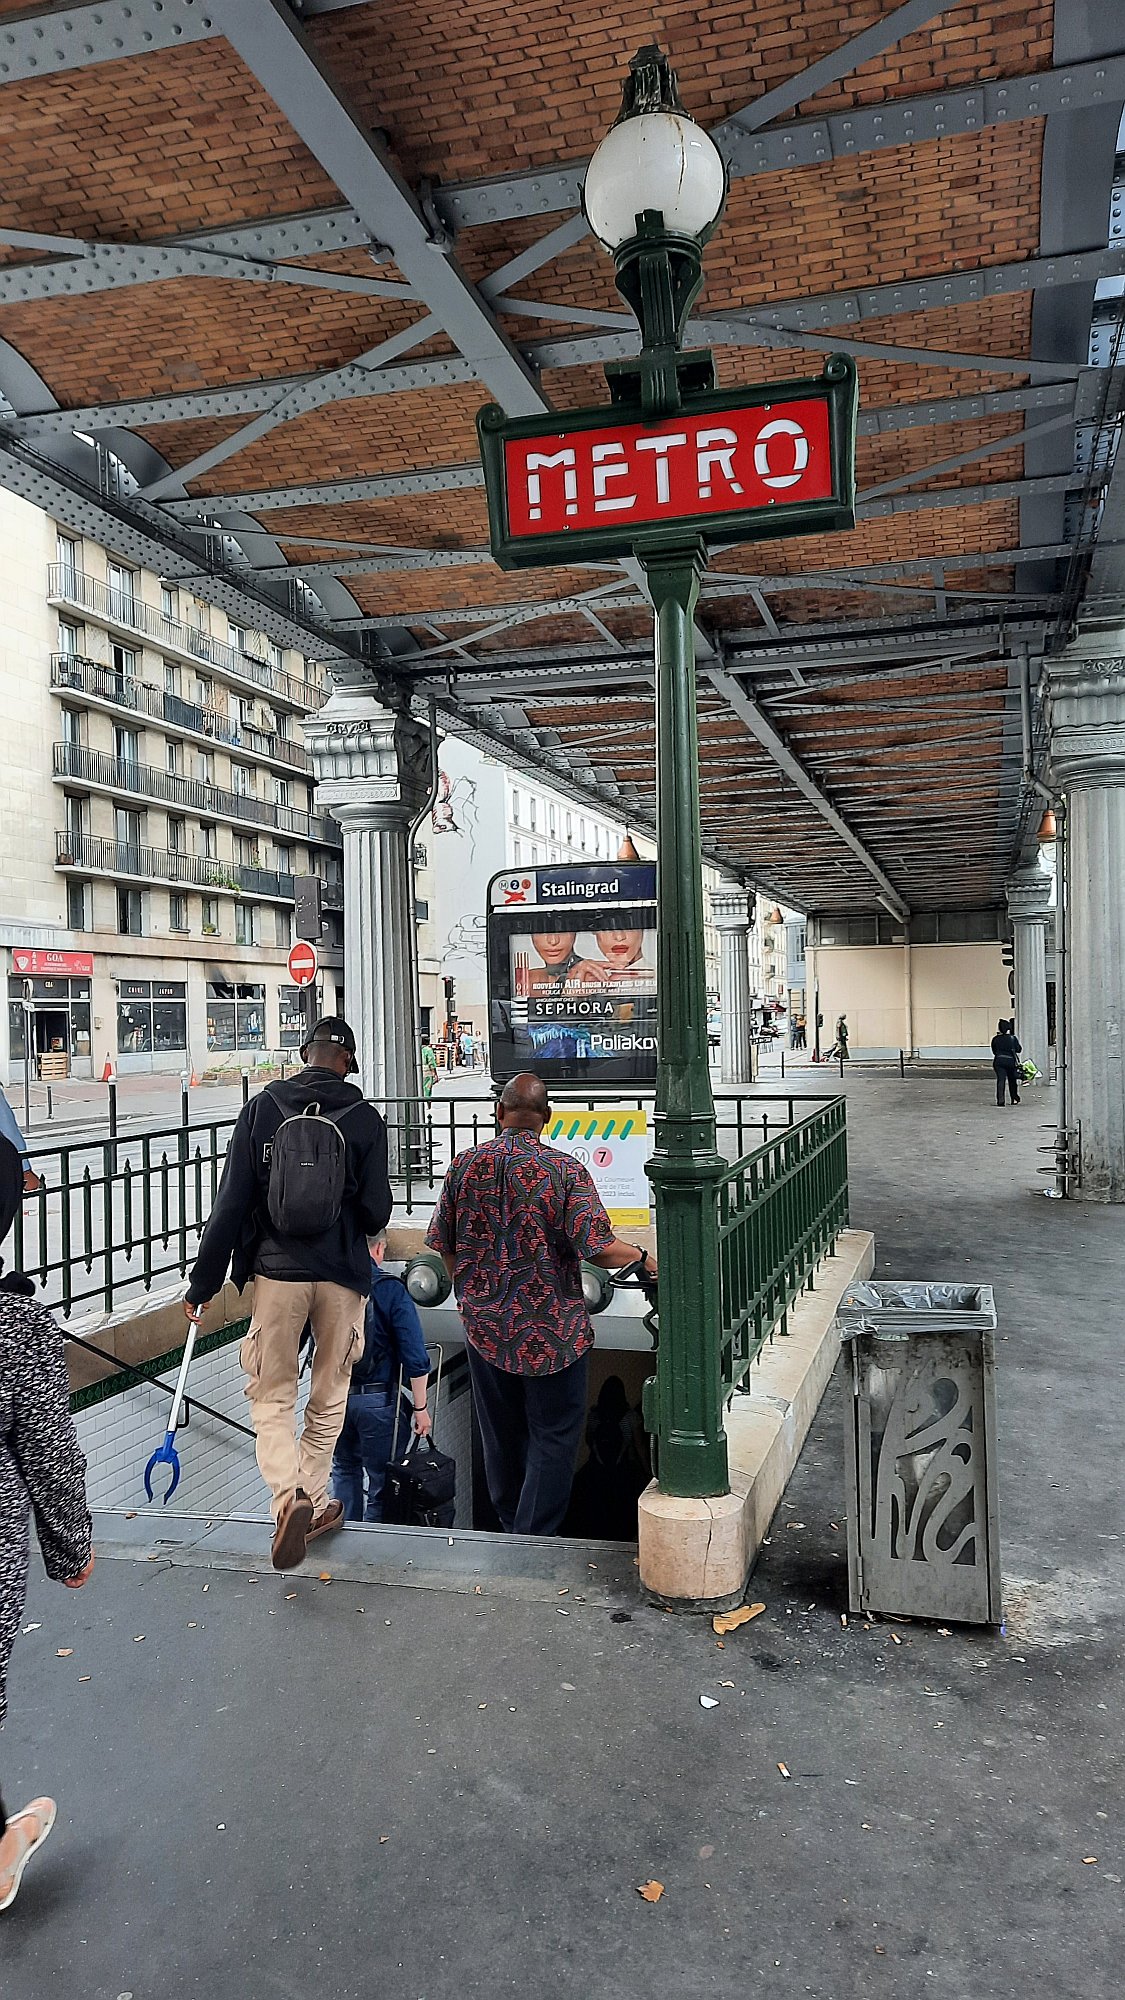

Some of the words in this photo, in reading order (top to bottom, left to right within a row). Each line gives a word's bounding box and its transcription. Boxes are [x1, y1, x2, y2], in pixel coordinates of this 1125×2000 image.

[526, 418, 810, 520] METRO
[541, 879, 619, 898] Stalingrad
[46, 953, 64, 962] GOA
[564, 979, 581, 989] AIR
[535, 1001, 614, 1015] SEPHORA
[598, 1151, 607, 1163] 7
